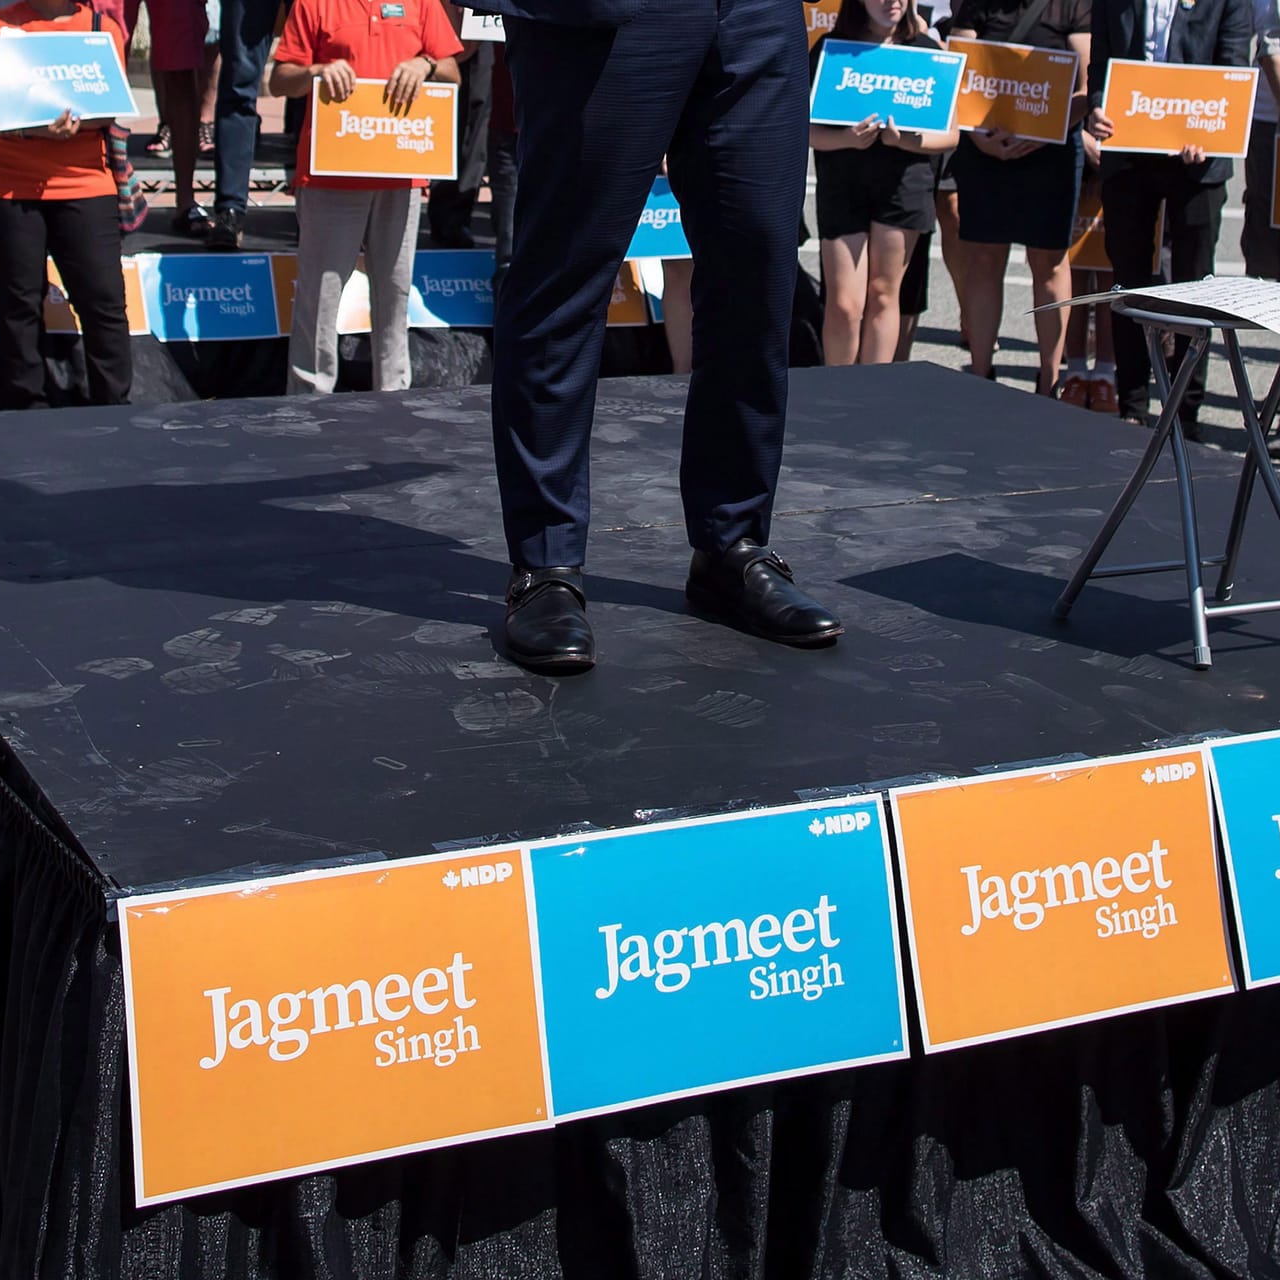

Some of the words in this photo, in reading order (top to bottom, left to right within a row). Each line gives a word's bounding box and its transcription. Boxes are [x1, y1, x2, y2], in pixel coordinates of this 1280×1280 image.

[30, 61, 105, 86] gmeet
[72, 79, 109, 95] Singh
[835, 66, 936, 96] Jagmeet
[961, 69, 1051, 101] Jagmeet
[892, 90, 932, 109] Singh
[1014, 97, 1049, 117] Singh
[1125, 90, 1229, 120] Jagmeet
[335, 110, 434, 140] Jagmeet
[1186, 114, 1226, 133] Singh
[396, 136, 434, 153] Singh
[219, 302, 256, 317] Singh
[1155, 761, 1196, 784] NDP
[825, 811, 871, 835] NDP
[460, 861, 513, 888] NDP
[960, 839, 1173, 936] Jagmeet
[1095, 894, 1178, 939] Singh
[594, 895, 840, 1000] Jagmeet
[749, 954, 845, 1001] Singh
[199, 951, 477, 1070] Jagmeet
[374, 1015, 482, 1068] Singh
